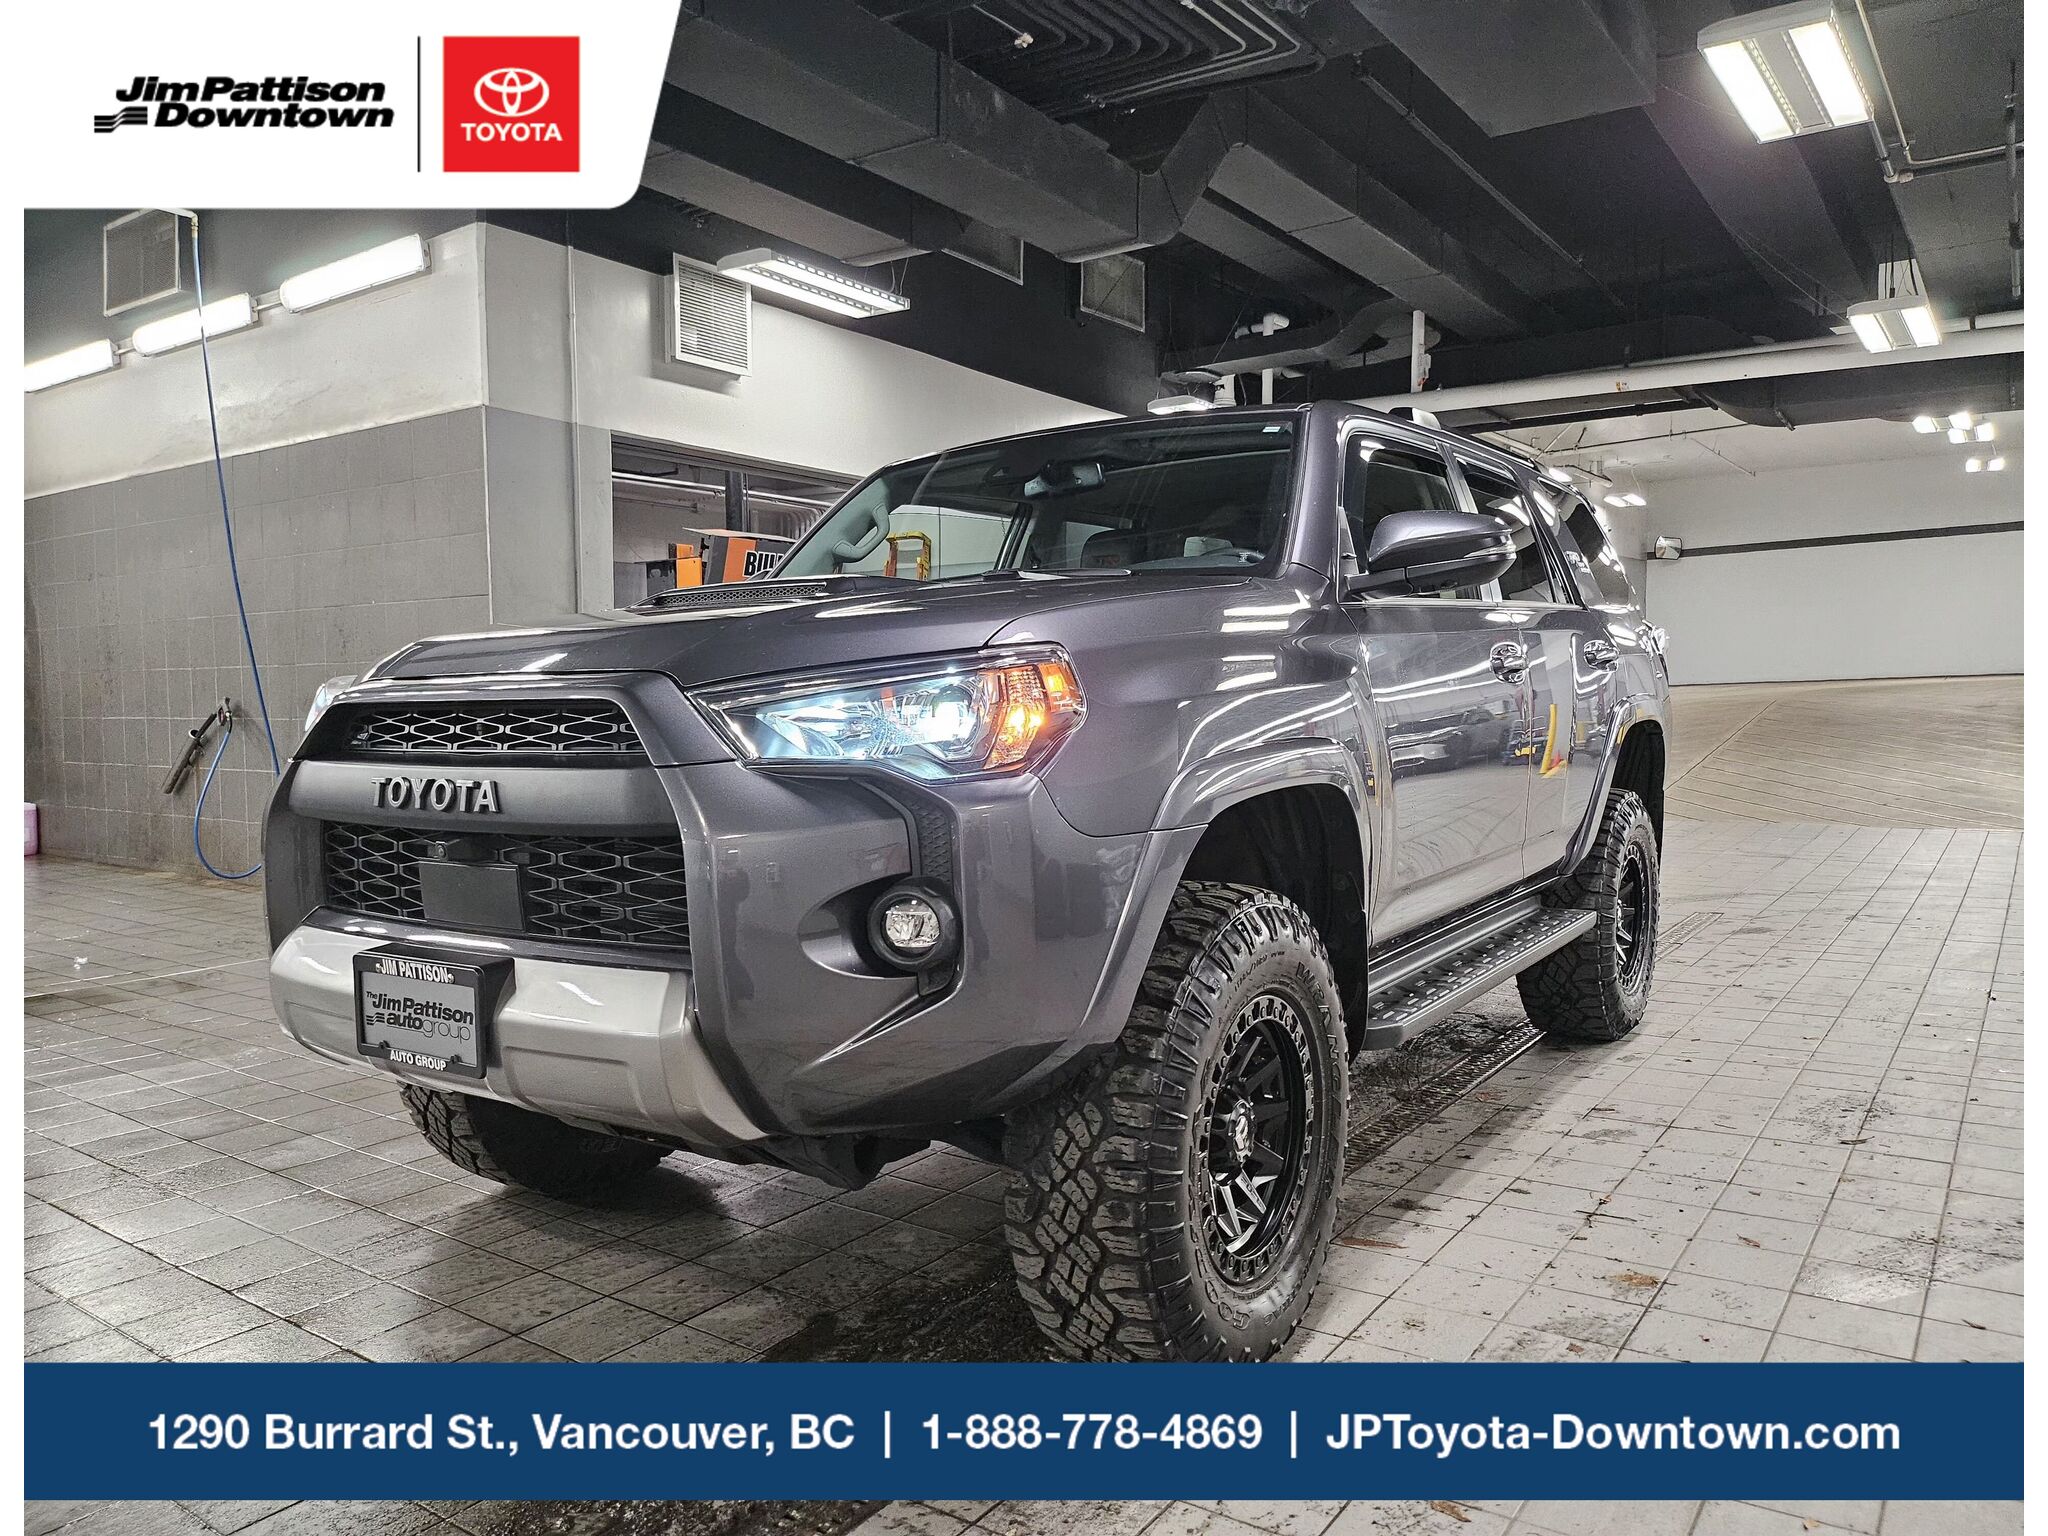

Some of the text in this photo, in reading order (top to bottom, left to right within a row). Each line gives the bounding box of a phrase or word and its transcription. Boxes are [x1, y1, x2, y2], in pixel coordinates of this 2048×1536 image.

[371, 776, 501, 813] TOYOTA
[381, 959, 449, 983] JIM PATTISON
[366, 991, 378, 1000] The
[390, 1050, 447, 1071] AUTO GROUP
